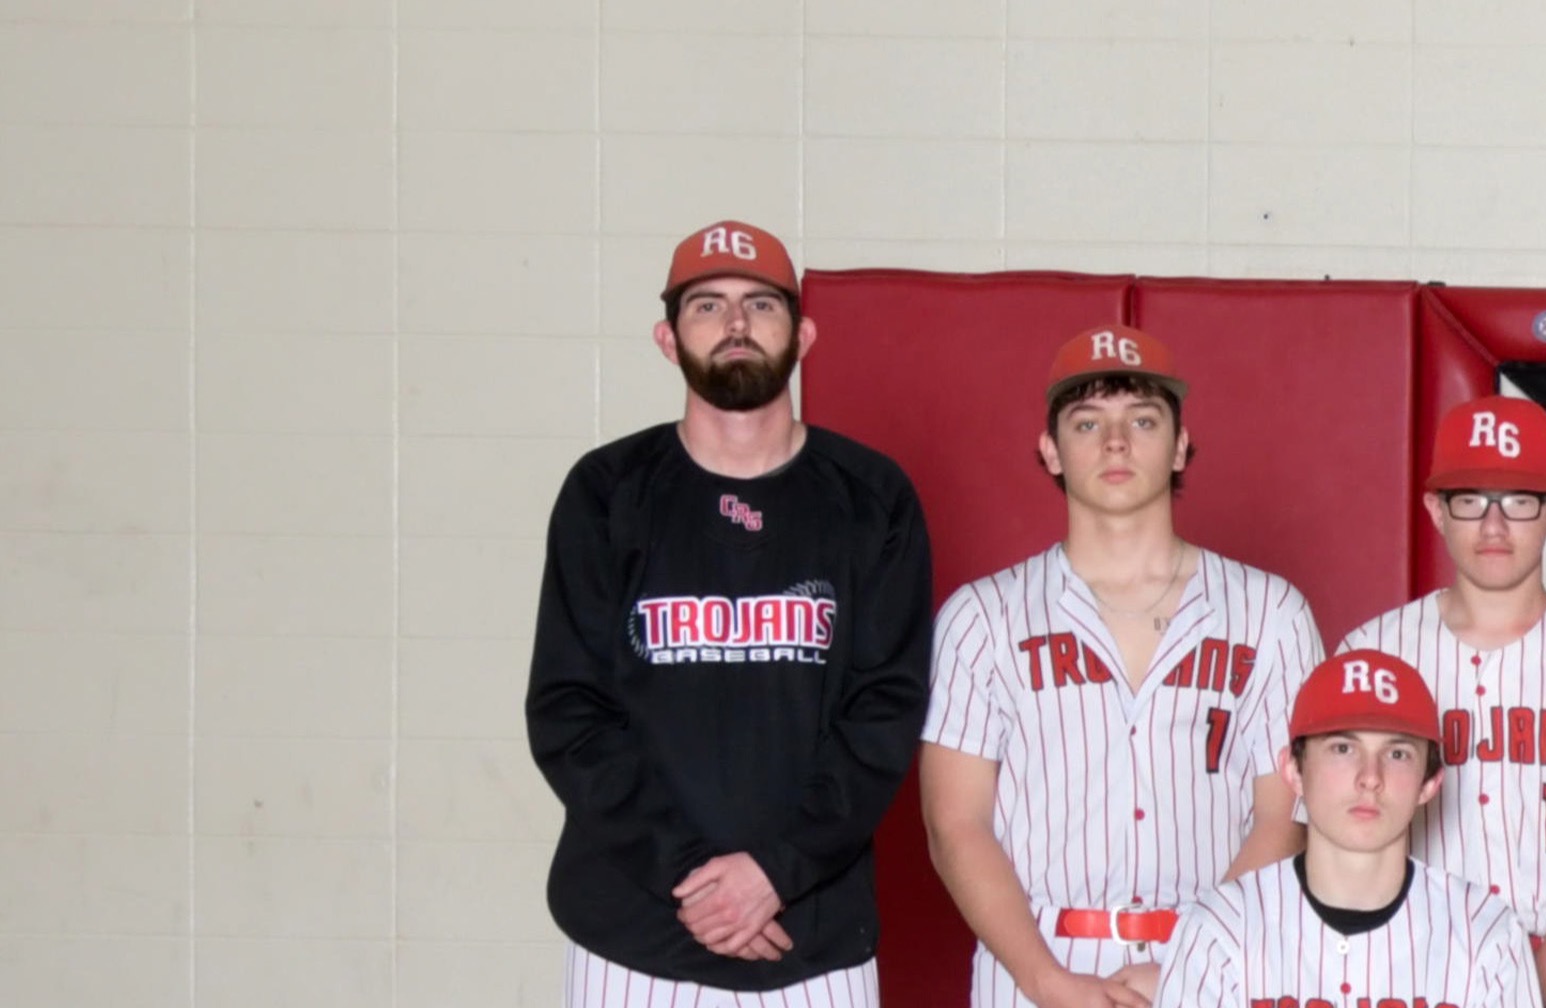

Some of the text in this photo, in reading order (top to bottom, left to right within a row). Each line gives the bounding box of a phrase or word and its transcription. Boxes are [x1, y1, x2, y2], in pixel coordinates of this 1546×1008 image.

[702, 225, 758, 261] R6
[1091, 331, 1142, 367] R6
[1468, 410, 1522, 459] R6
[638, 597, 835, 649] TROJANS
[651, 647, 827, 665] BASEBALL
[1341, 658, 1400, 705] R6
[1206, 706, 1231, 774] 1
